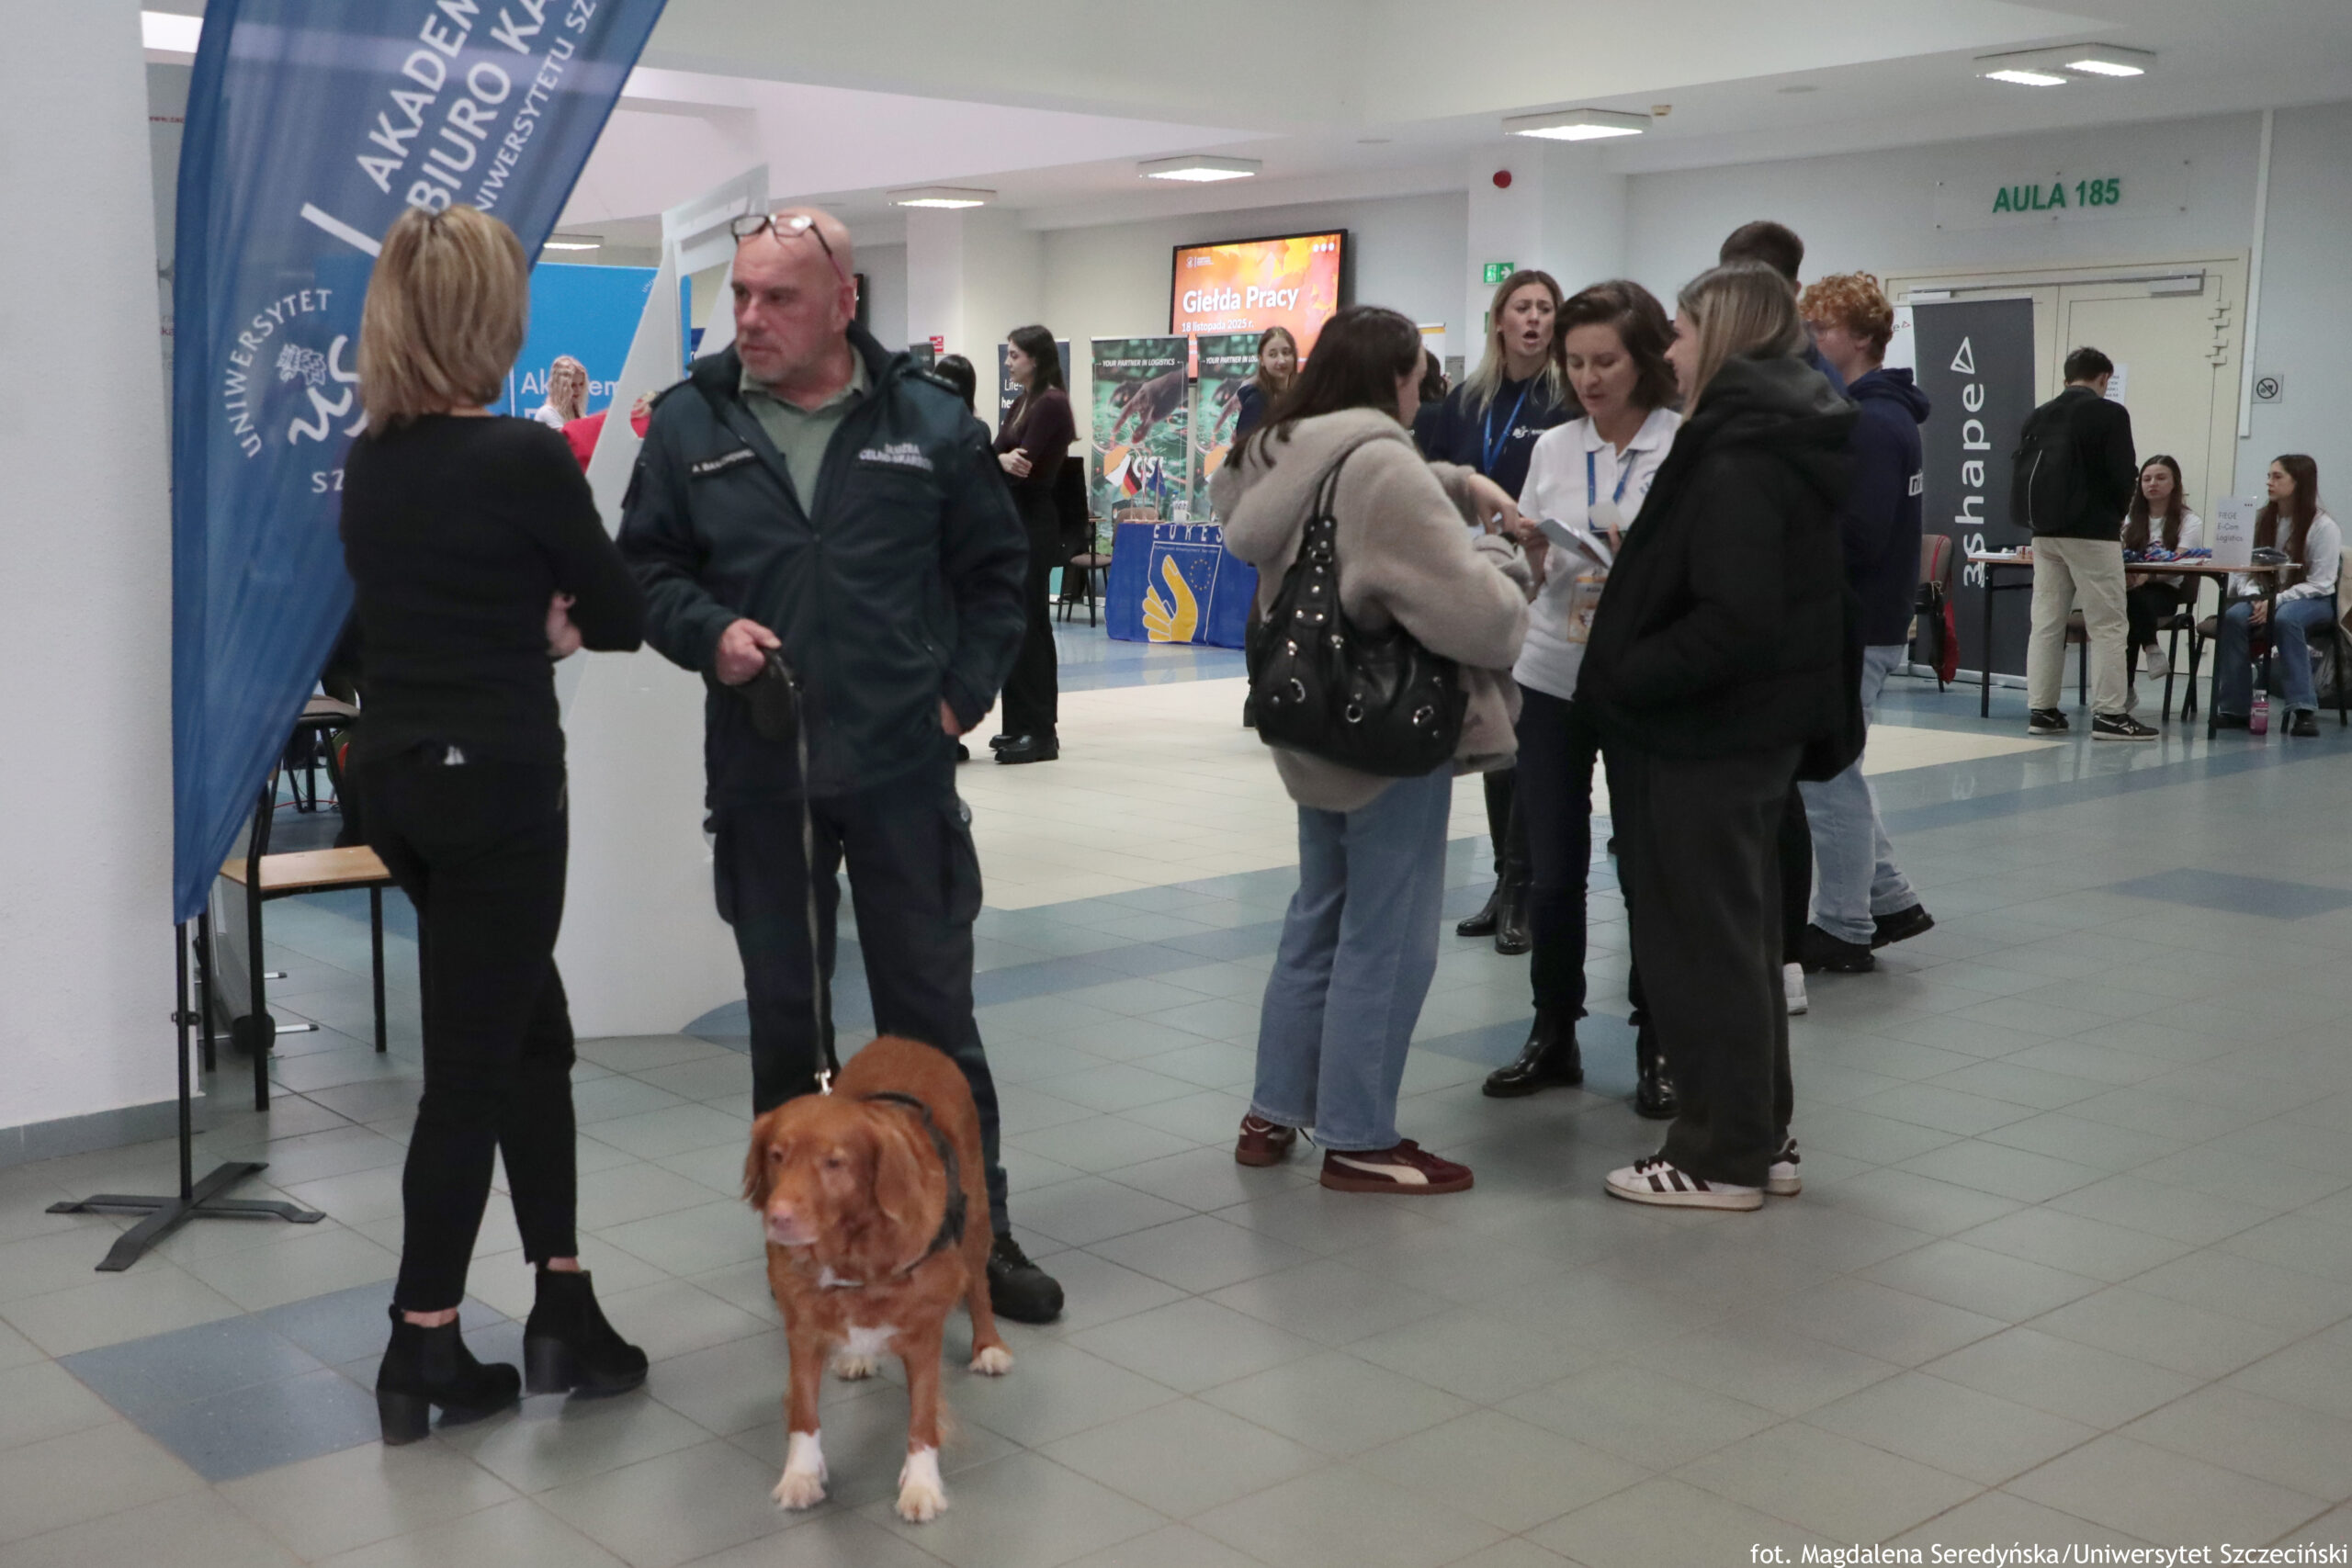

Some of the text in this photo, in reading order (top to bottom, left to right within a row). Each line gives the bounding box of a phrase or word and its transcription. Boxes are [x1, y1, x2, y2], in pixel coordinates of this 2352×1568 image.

[474, 37, 575, 211] NIWERSYTETU
[405, 62, 511, 216] BIURO
[1992, 178, 2120, 213] AULA 185
[1182, 286, 1299, 313] Giełda Pracy
[1182, 322, 1192, 333] 18
[1193, 321, 1226, 333] listopada
[1227, 319, 1247, 330] 2025
[224, 288, 333, 457] UNIWERSYTET
[1102, 359, 1116, 367] YOUR
[1117, 358, 1139, 367] PARTNER
[1148, 357, 1175, 366] LOGISTICS
[1220, 355, 1241, 364] PARTNER
[1004, 378, 1024, 391] Life-
[1954, 383, 1992, 589] 3shape
[2216, 534, 2244, 543] Logistics
